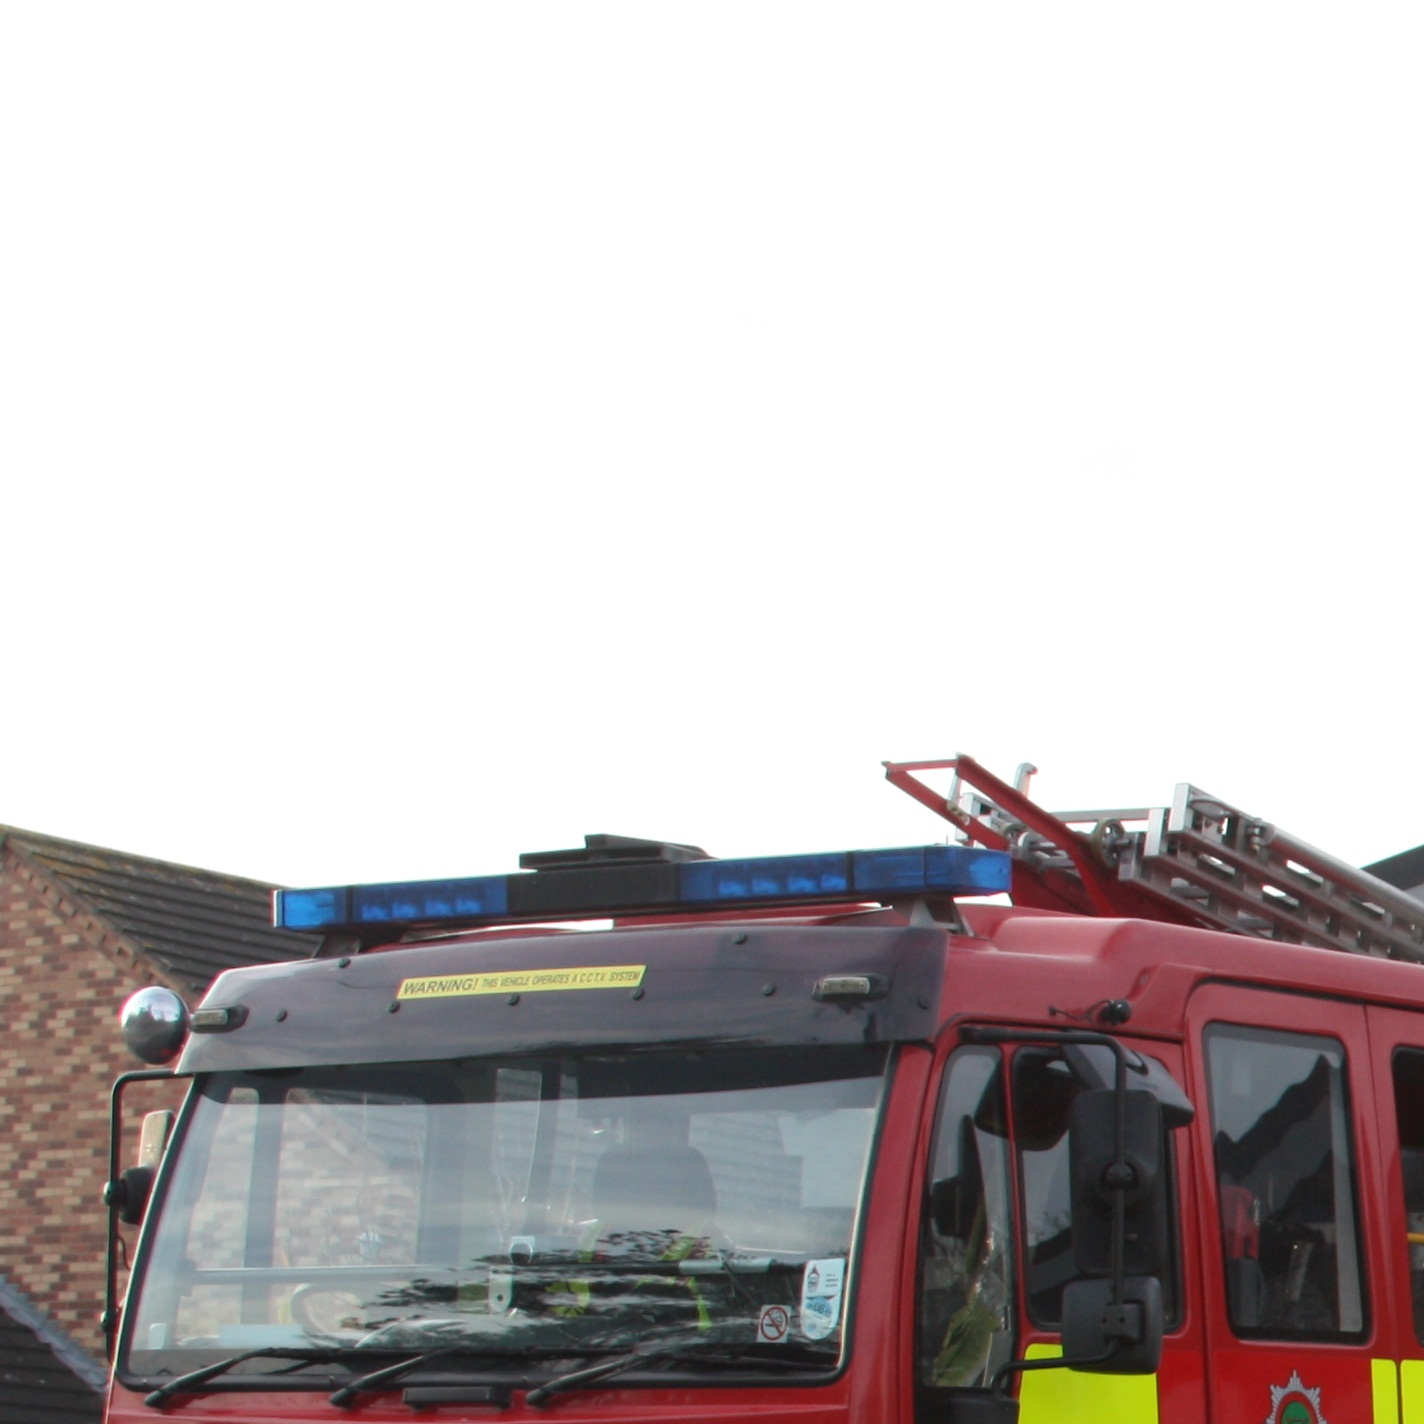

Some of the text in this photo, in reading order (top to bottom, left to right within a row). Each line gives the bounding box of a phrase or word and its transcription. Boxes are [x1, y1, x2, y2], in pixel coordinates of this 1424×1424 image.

[404, 978, 478, 994] WARNING!
[482, 977, 498, 988] THIS
[501, 975, 530, 987] VEHICLE
[532, 973, 570, 985] OPERATES
[609, 971, 640, 981] SYSTEM
